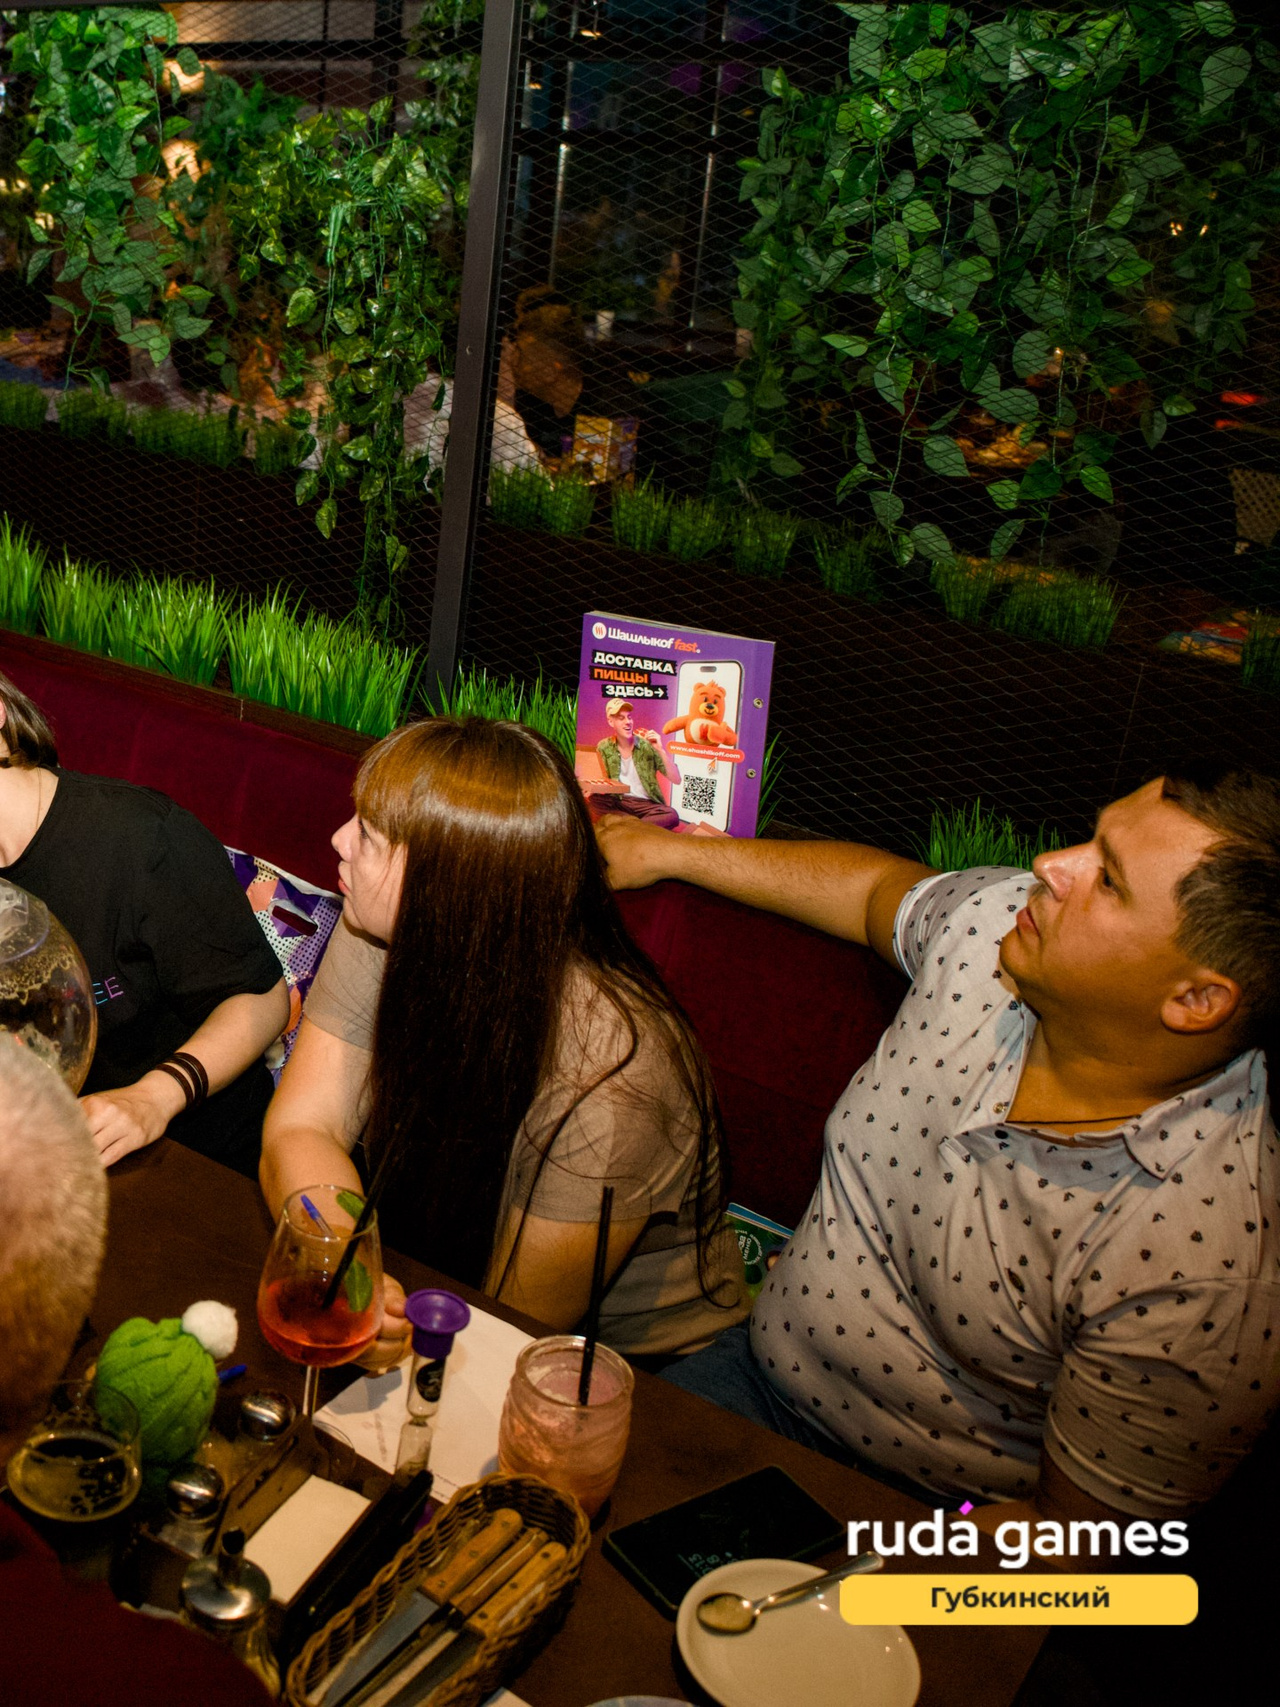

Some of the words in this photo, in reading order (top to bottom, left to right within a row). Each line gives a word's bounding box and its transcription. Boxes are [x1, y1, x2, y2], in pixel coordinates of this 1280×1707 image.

[594, 651, 674, 674] ДОСТАВКА
[593, 668, 648, 684] ПИЦЦЫ
[605, 685, 654, 697] ЗДЕСЬ
